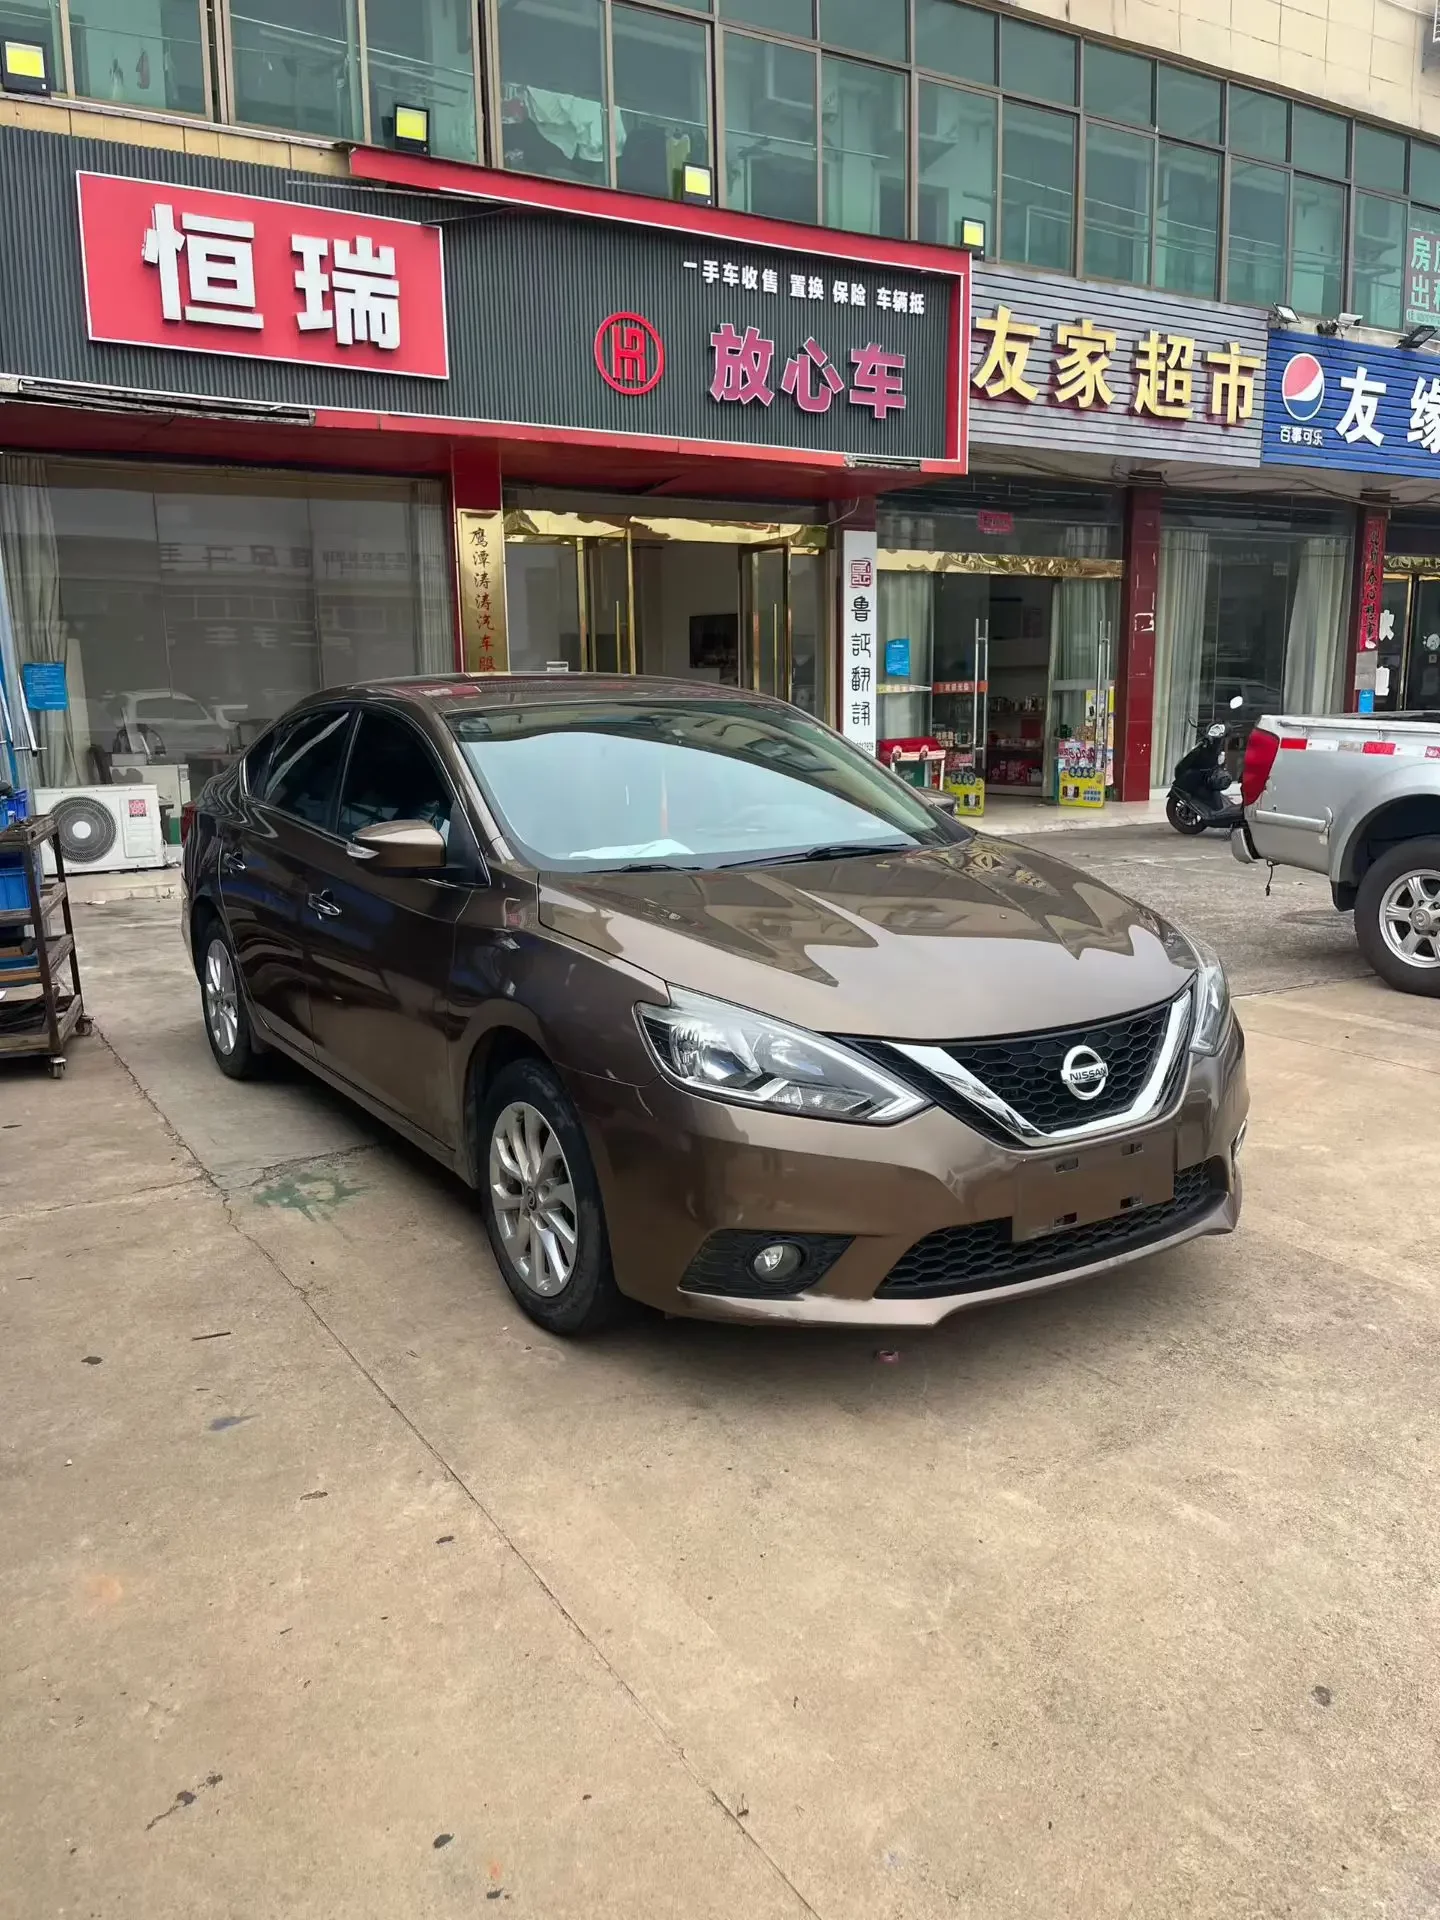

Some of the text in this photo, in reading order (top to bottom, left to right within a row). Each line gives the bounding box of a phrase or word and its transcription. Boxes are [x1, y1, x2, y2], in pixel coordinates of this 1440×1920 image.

[142, 203, 401, 350] 恒瑞
[790, 274, 824, 300] 置换
[832, 280, 866, 306] 保险
[710, 323, 907, 419] 放心车
[971, 304, 1262, 426] 友家超市
[1069, 1067, 1107, 1081] NISSAN
